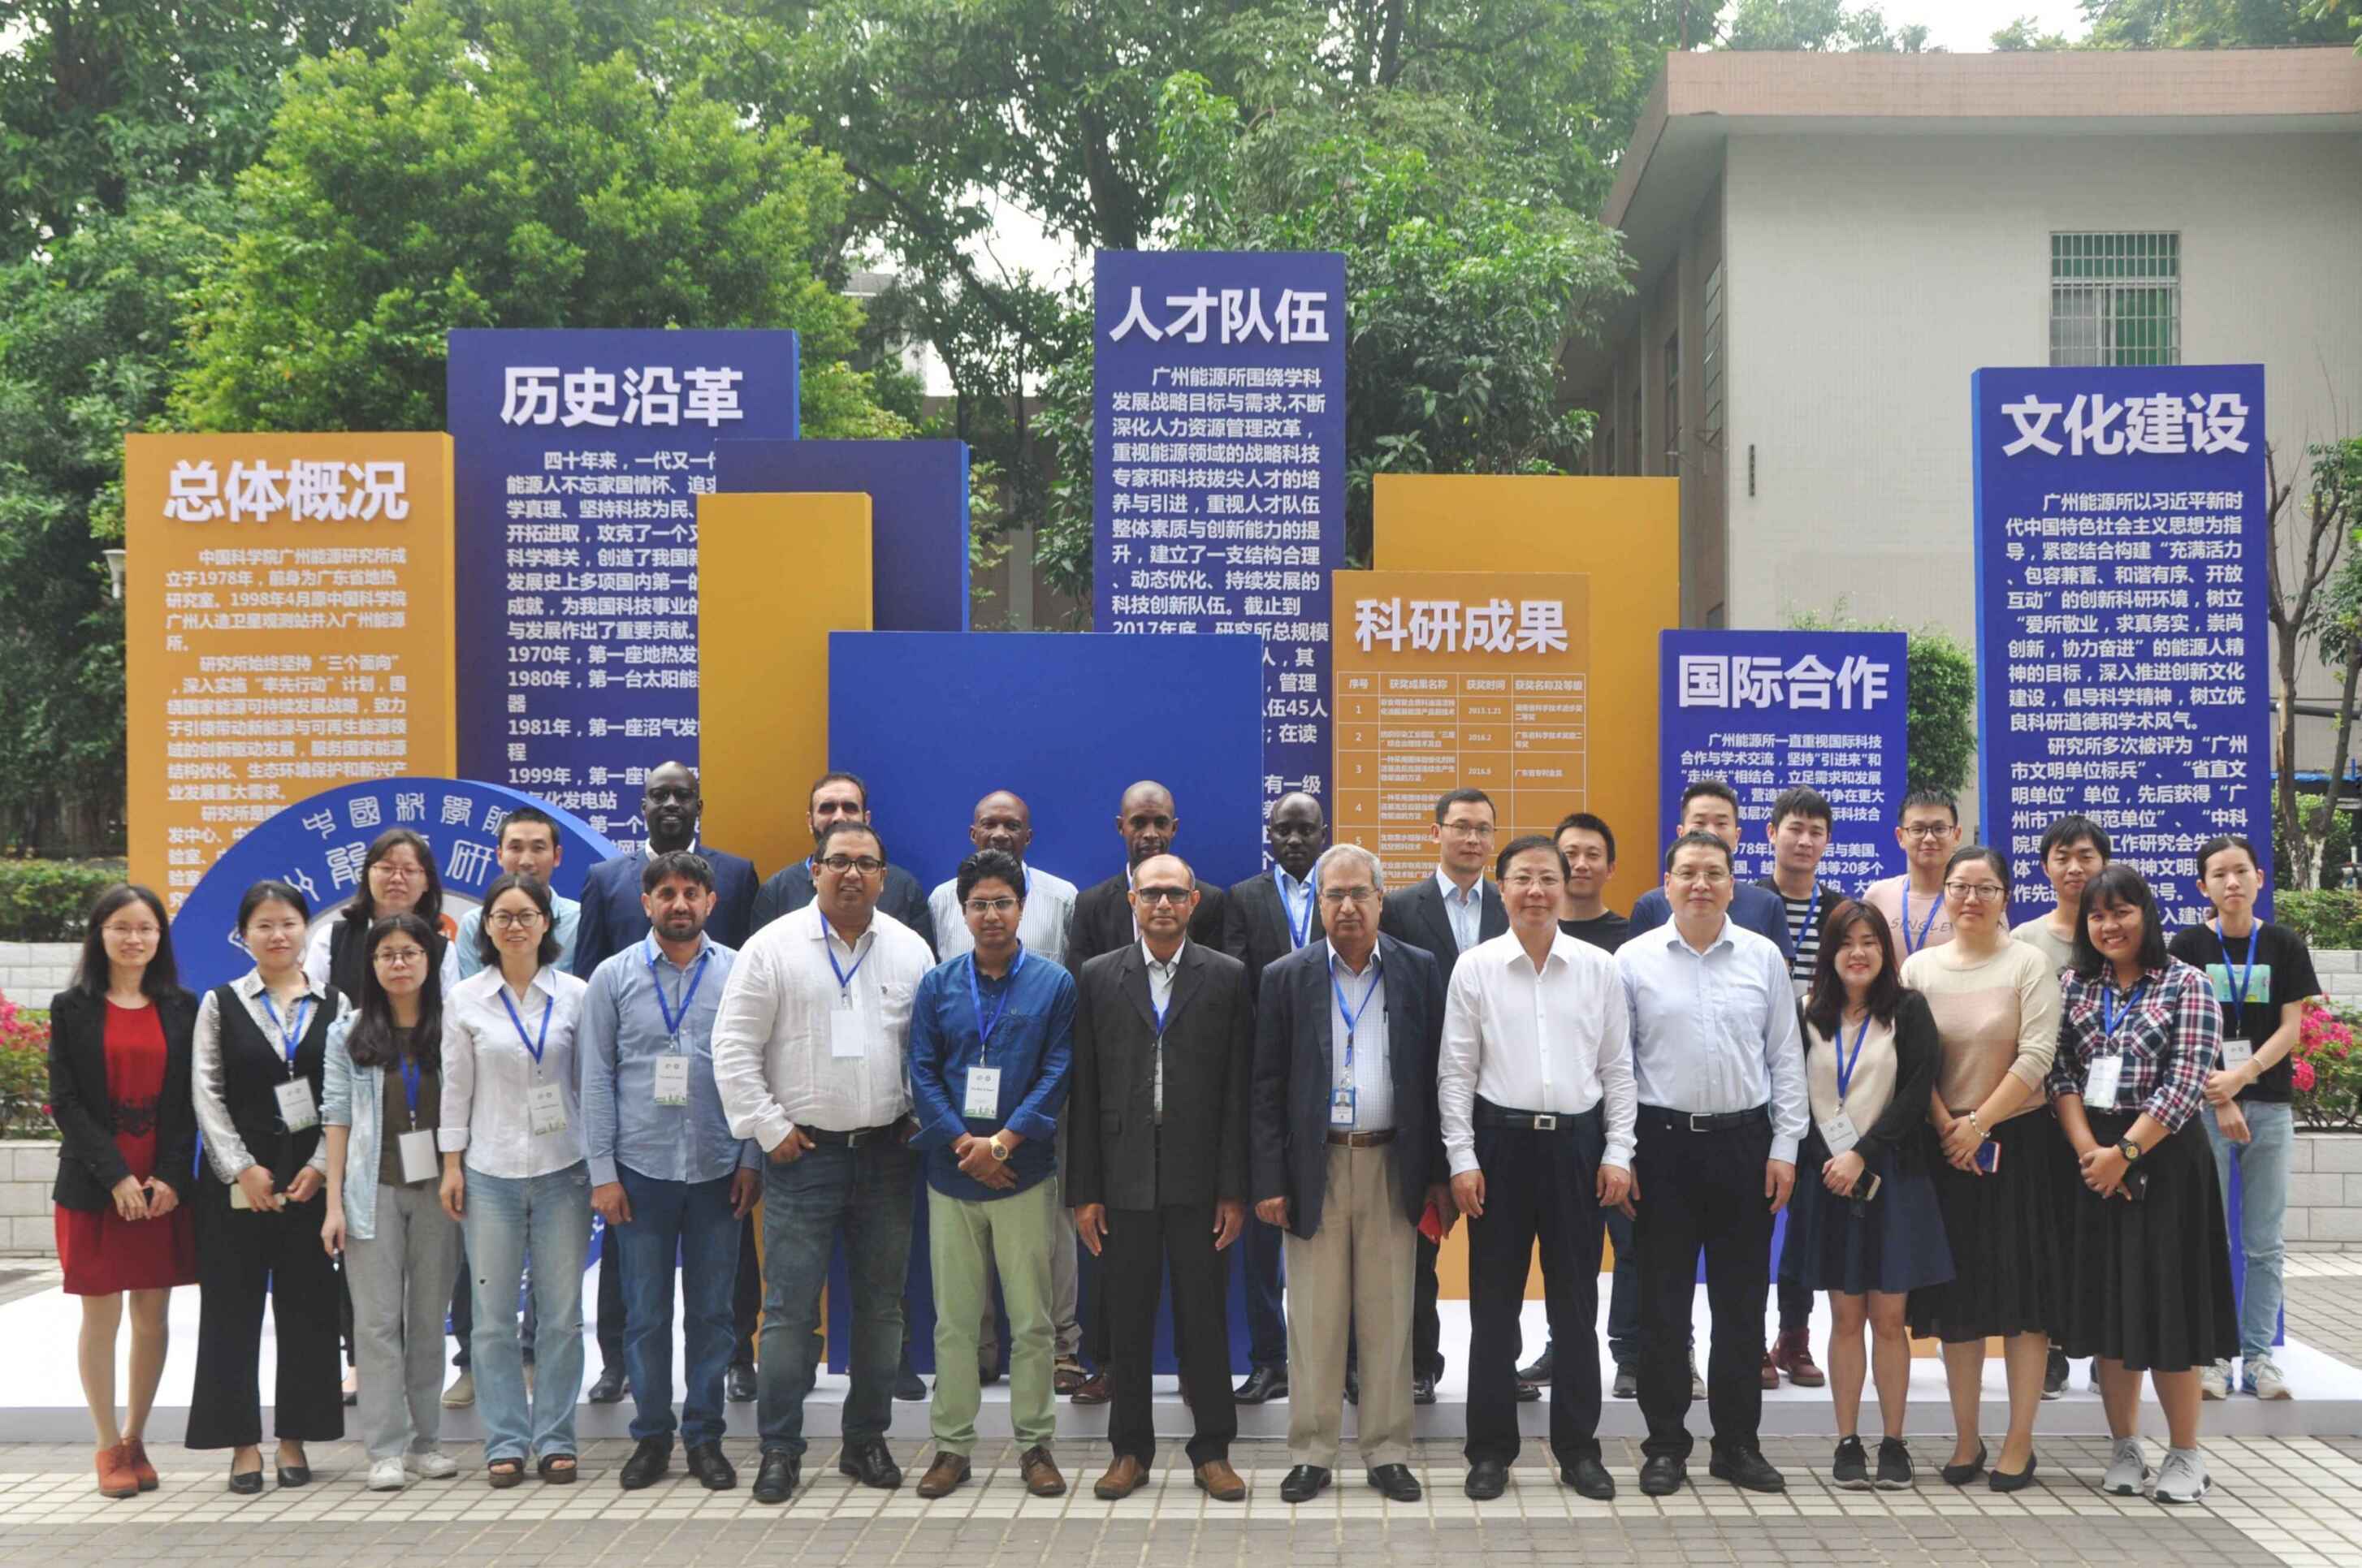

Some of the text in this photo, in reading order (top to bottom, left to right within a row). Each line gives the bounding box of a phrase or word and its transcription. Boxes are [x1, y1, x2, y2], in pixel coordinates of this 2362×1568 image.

[1109, 286, 1330, 343] 人才队伍
[1152, 366, 1322, 388] 广州能源所围绕学科
[500, 367, 743, 427] 历史沿革
[1112, 417, 1313, 439] 深化人力资源管理改革，
[2001, 392, 2250, 456] 文化建设
[1112, 443, 1320, 464] 重视能源领域的战略科技
[1112, 469, 1321, 490] 专家和科技拔尖人才的培
[163, 460, 409, 522] 总体概况
[2043, 491, 2243, 512] 广州能源所以习近平新时
[506, 499, 696, 519] 学真理、坚持科技为民、
[1112, 494, 1321, 515] 养与引进，重视人才队伍
[1112, 519, 1321, 541] 整体素质与创新能力的提
[2005, 516, 2242, 537] 代中国特色社会主义思想为指
[1112, 544, 1321, 566] 升，建立了一支结构合理
[2006, 540, 2242, 562] 导，紧密结合构建“充满活力
[1112, 570, 1320, 591] 、动态优化、持续发展的
[1112, 595, 1300, 616] 科技创新队伍。截止到
[507, 621, 696, 640] 与发展作出了重要贡献。
[1354, 597, 1568, 654] 科研成果
[508, 645, 699, 664] 1970年，第一座地热发
[508, 670, 699, 689] 1980年，第一台太阳能
[1679, 654, 1889, 710] 国际合作
[2009, 663, 2245, 683] 神的目标，深入推进创新文化
[508, 694, 526, 713] 器
[2009, 687, 2246, 707] 建设，倡导科学精神，树立优
[1262, 699, 1328, 718] 伍45人
[508, 718, 700, 737] 1981年，第一座沼气发
[2010, 712, 2200, 732] 良科研道德和学术风气。
[1708, 733, 1882, 749] 广州能源所一直重视国际科技
[2048, 736, 2248, 756] 研究所多次被评为“广州
[508, 743, 526, 762] 程
[508, 767, 699, 785] 1999年，第一座
